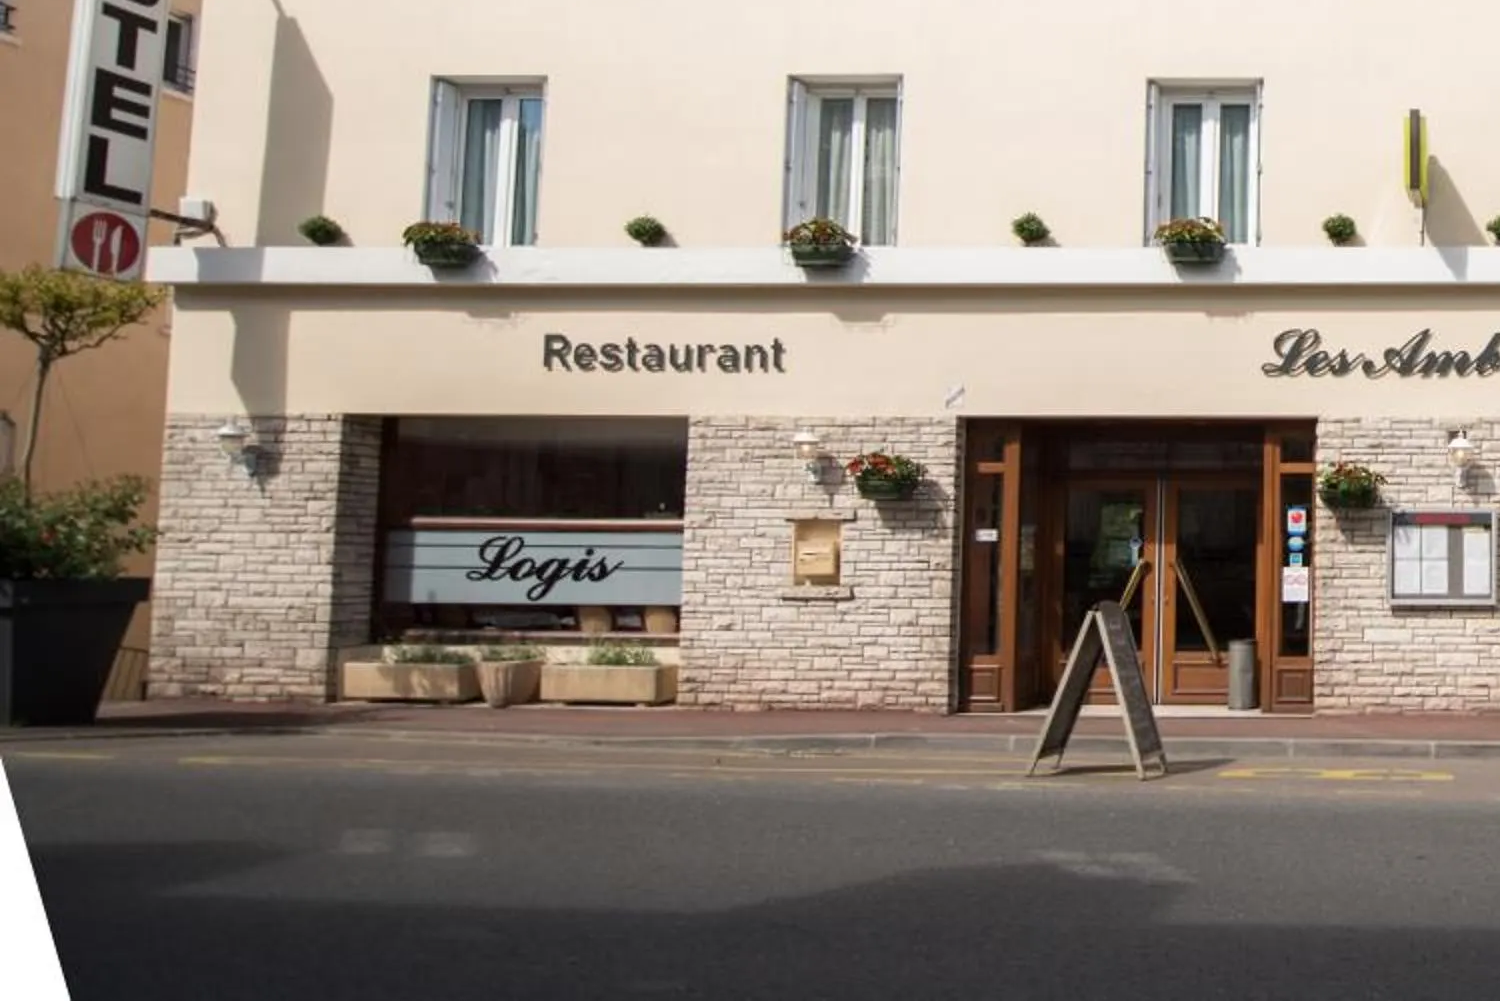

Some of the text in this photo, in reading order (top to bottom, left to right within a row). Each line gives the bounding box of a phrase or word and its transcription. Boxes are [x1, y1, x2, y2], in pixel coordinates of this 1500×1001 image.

[543, 334, 786, 373] Restaurant
[1261, 328, 1364, 378] Les
[466, 536, 625, 601] Logis
